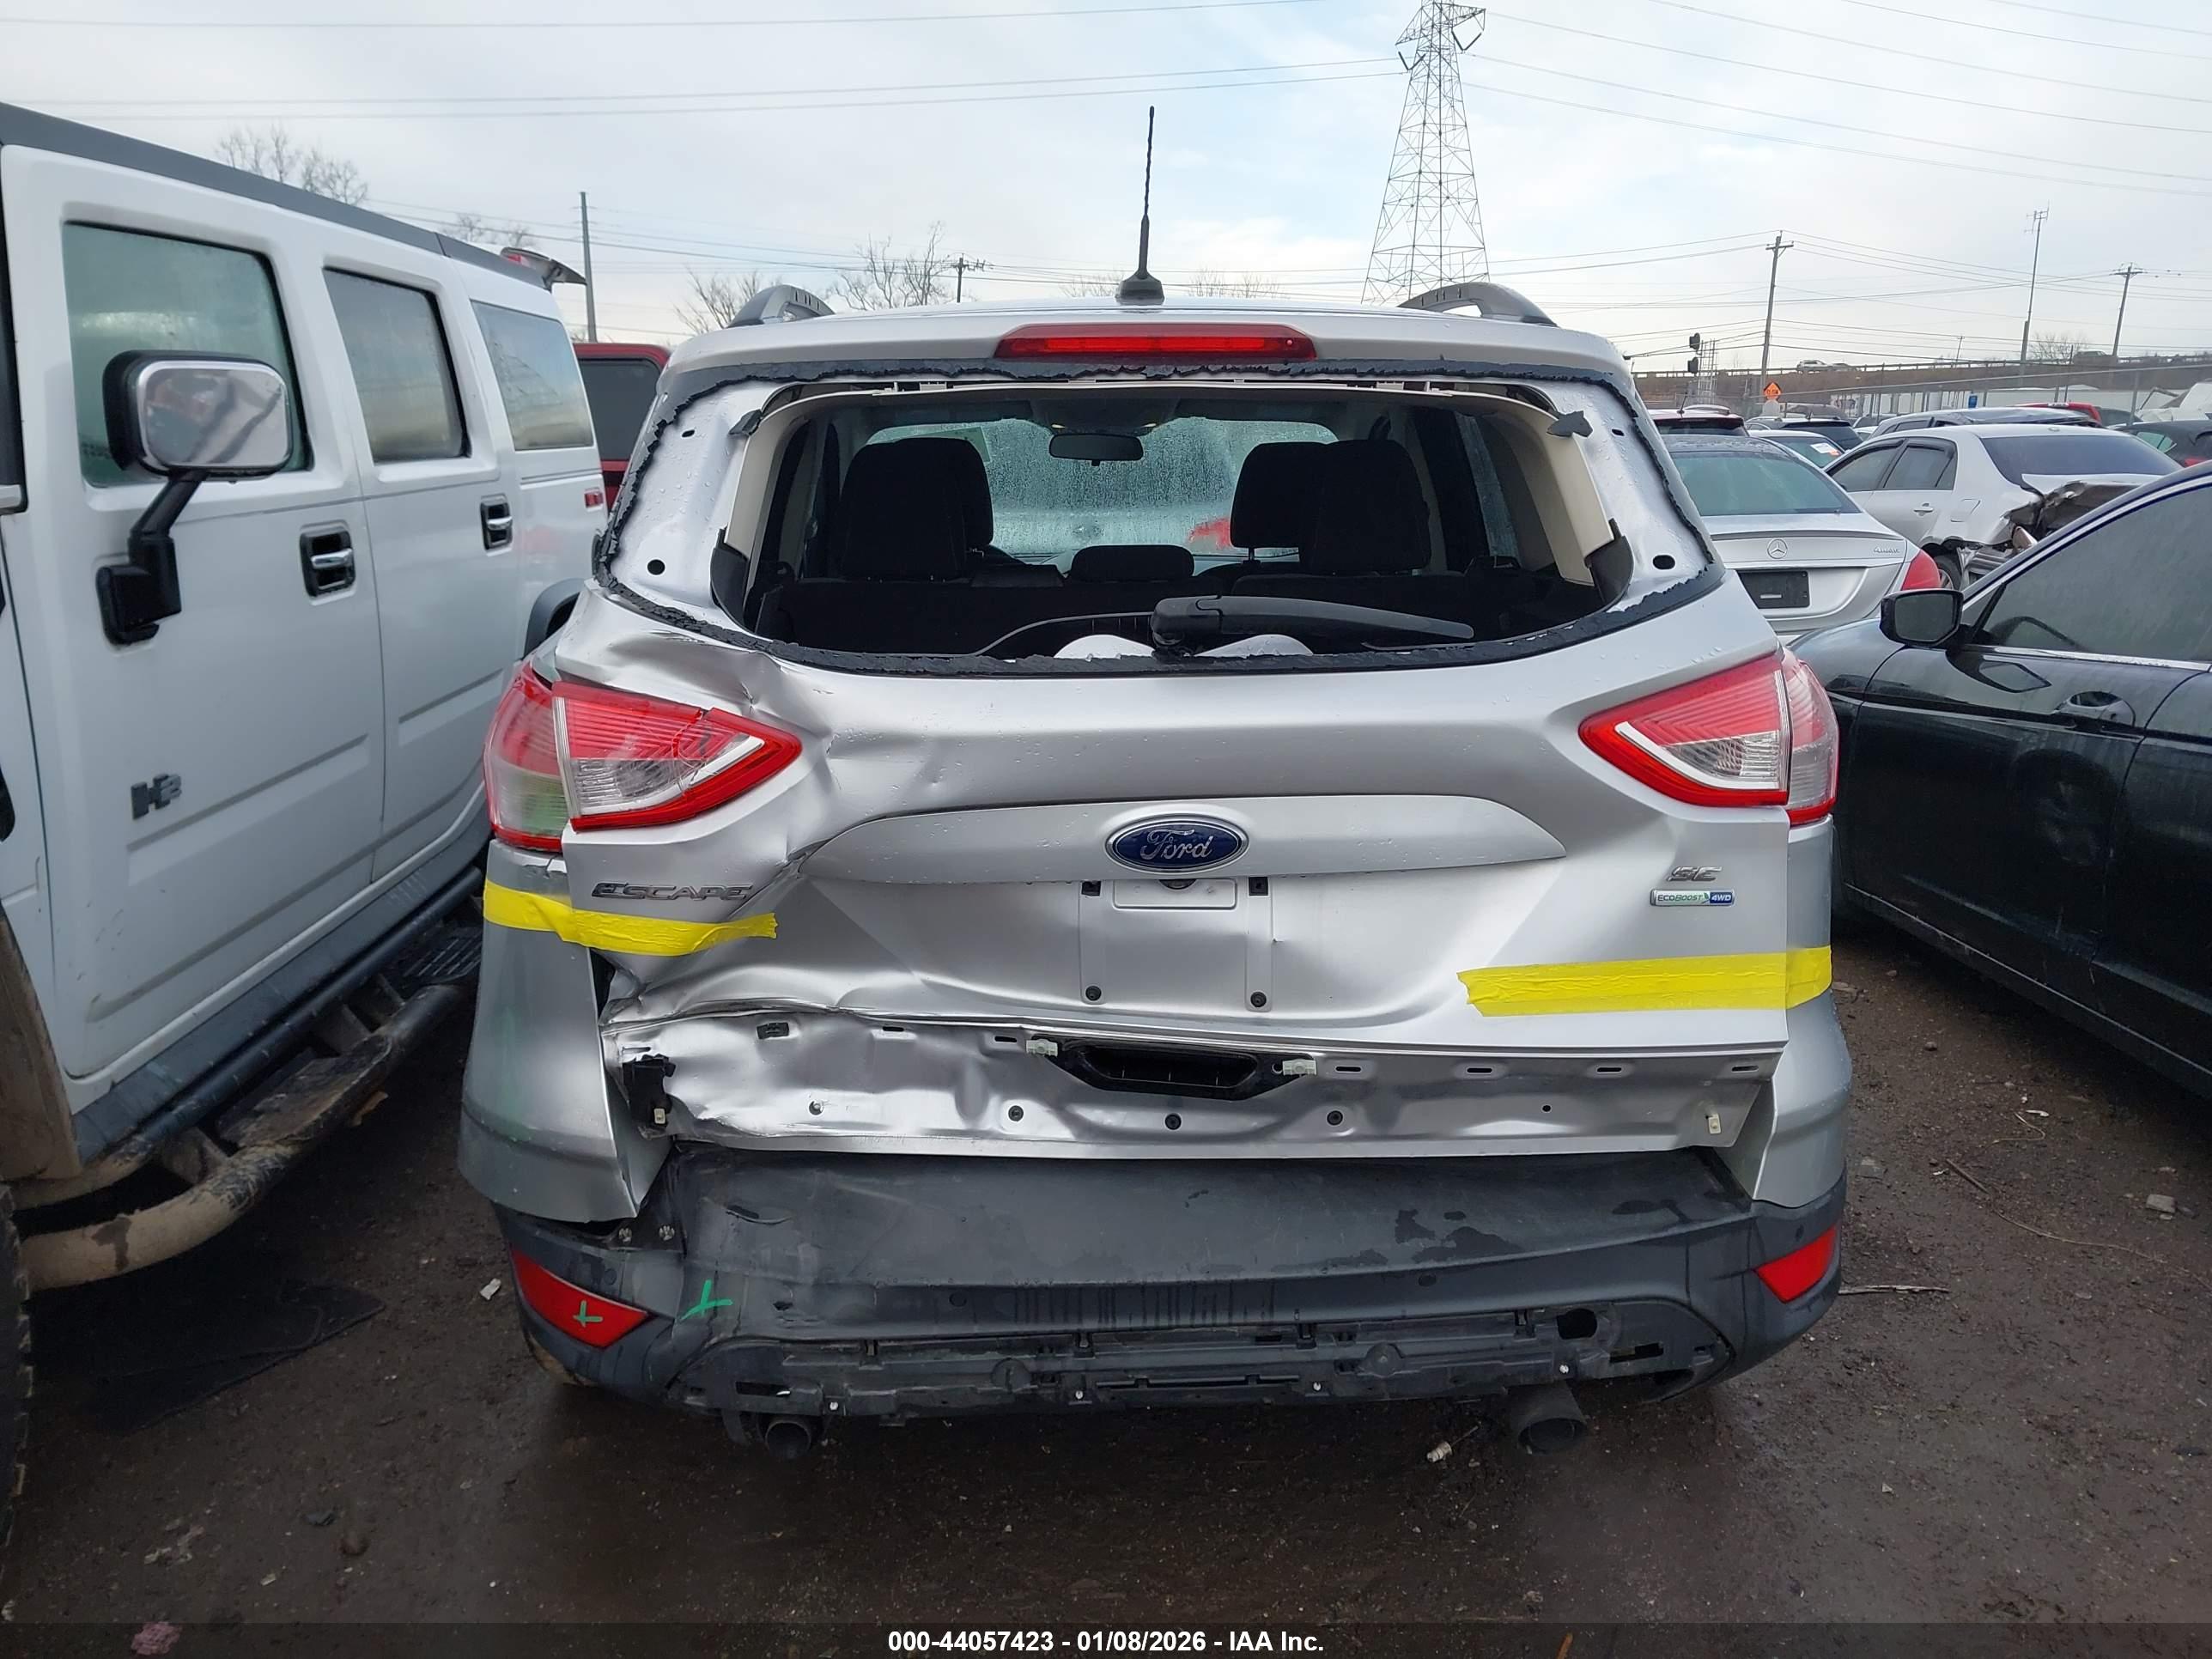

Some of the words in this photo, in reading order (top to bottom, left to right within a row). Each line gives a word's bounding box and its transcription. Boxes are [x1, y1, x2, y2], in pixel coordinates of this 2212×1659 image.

[1140, 829, 1214, 860] Ford
[1667, 866, 1723, 882] SE
[592, 882, 753, 900] ESCAPE
[1711, 894, 1732, 902] 4WD
